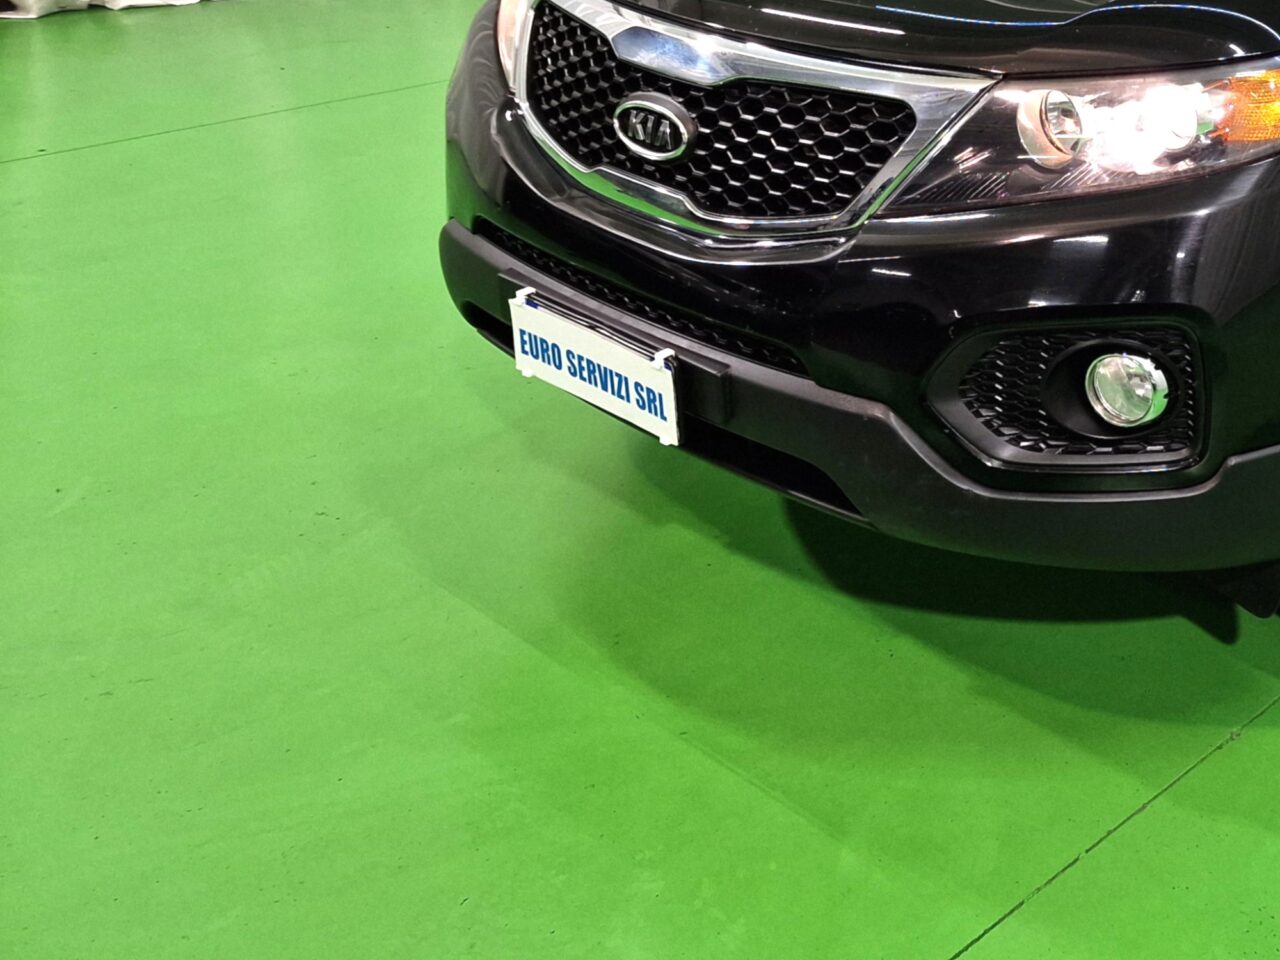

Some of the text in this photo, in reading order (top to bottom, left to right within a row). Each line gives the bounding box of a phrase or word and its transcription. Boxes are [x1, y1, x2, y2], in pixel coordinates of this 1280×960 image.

[627, 109, 672, 150] KIA
[519, 328, 668, 422] EURO SERVIZI SRL
